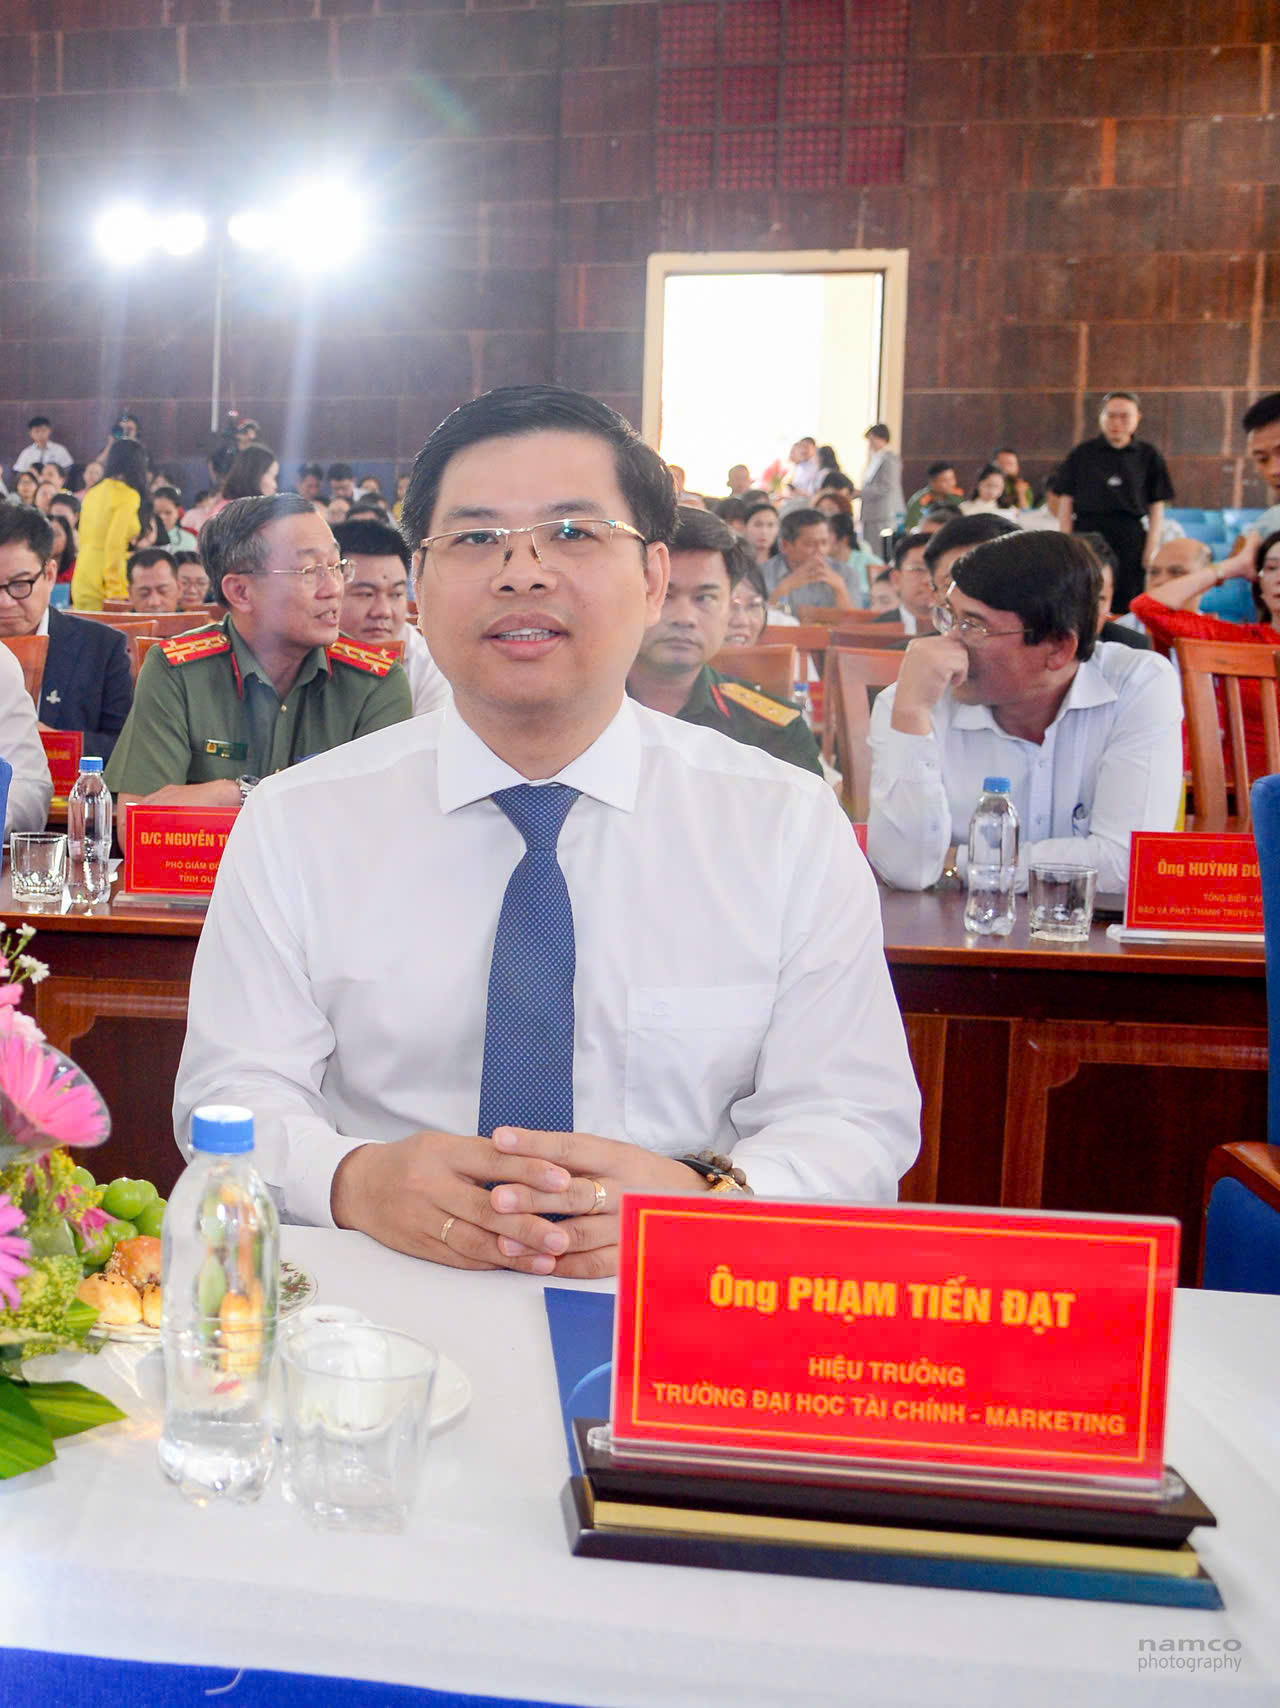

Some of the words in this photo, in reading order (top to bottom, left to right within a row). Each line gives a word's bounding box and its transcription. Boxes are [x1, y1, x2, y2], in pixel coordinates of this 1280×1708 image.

[140, 831, 162, 846] Đ/C
[164, 828, 215, 848] NGUYỄN
[185, 860, 207, 870] GIÁM
[1157, 858, 1185, 878] Ông
[1188, 860, 1238, 878] HUỲNH
[710, 1264, 777, 1313] Ông
[786, 1275, 897, 1323] PHẠM
[907, 1275, 992, 1324] TIẾN
[1000, 1288, 1077, 1335] ĐẠT
[808, 1354, 864, 1383] HIỆU
[867, 1357, 966, 1388] TRƯỞNG
[652, 1380, 747, 1409] TRƯỜNG
[751, 1389, 792, 1416] ĐẠI
[796, 1392, 846, 1417] HỌC
[850, 1392, 889, 1418] TÀI
[892, 1396, 966, 1425] CHÍNH
[985, 1406, 1127, 1436] MARKETING
